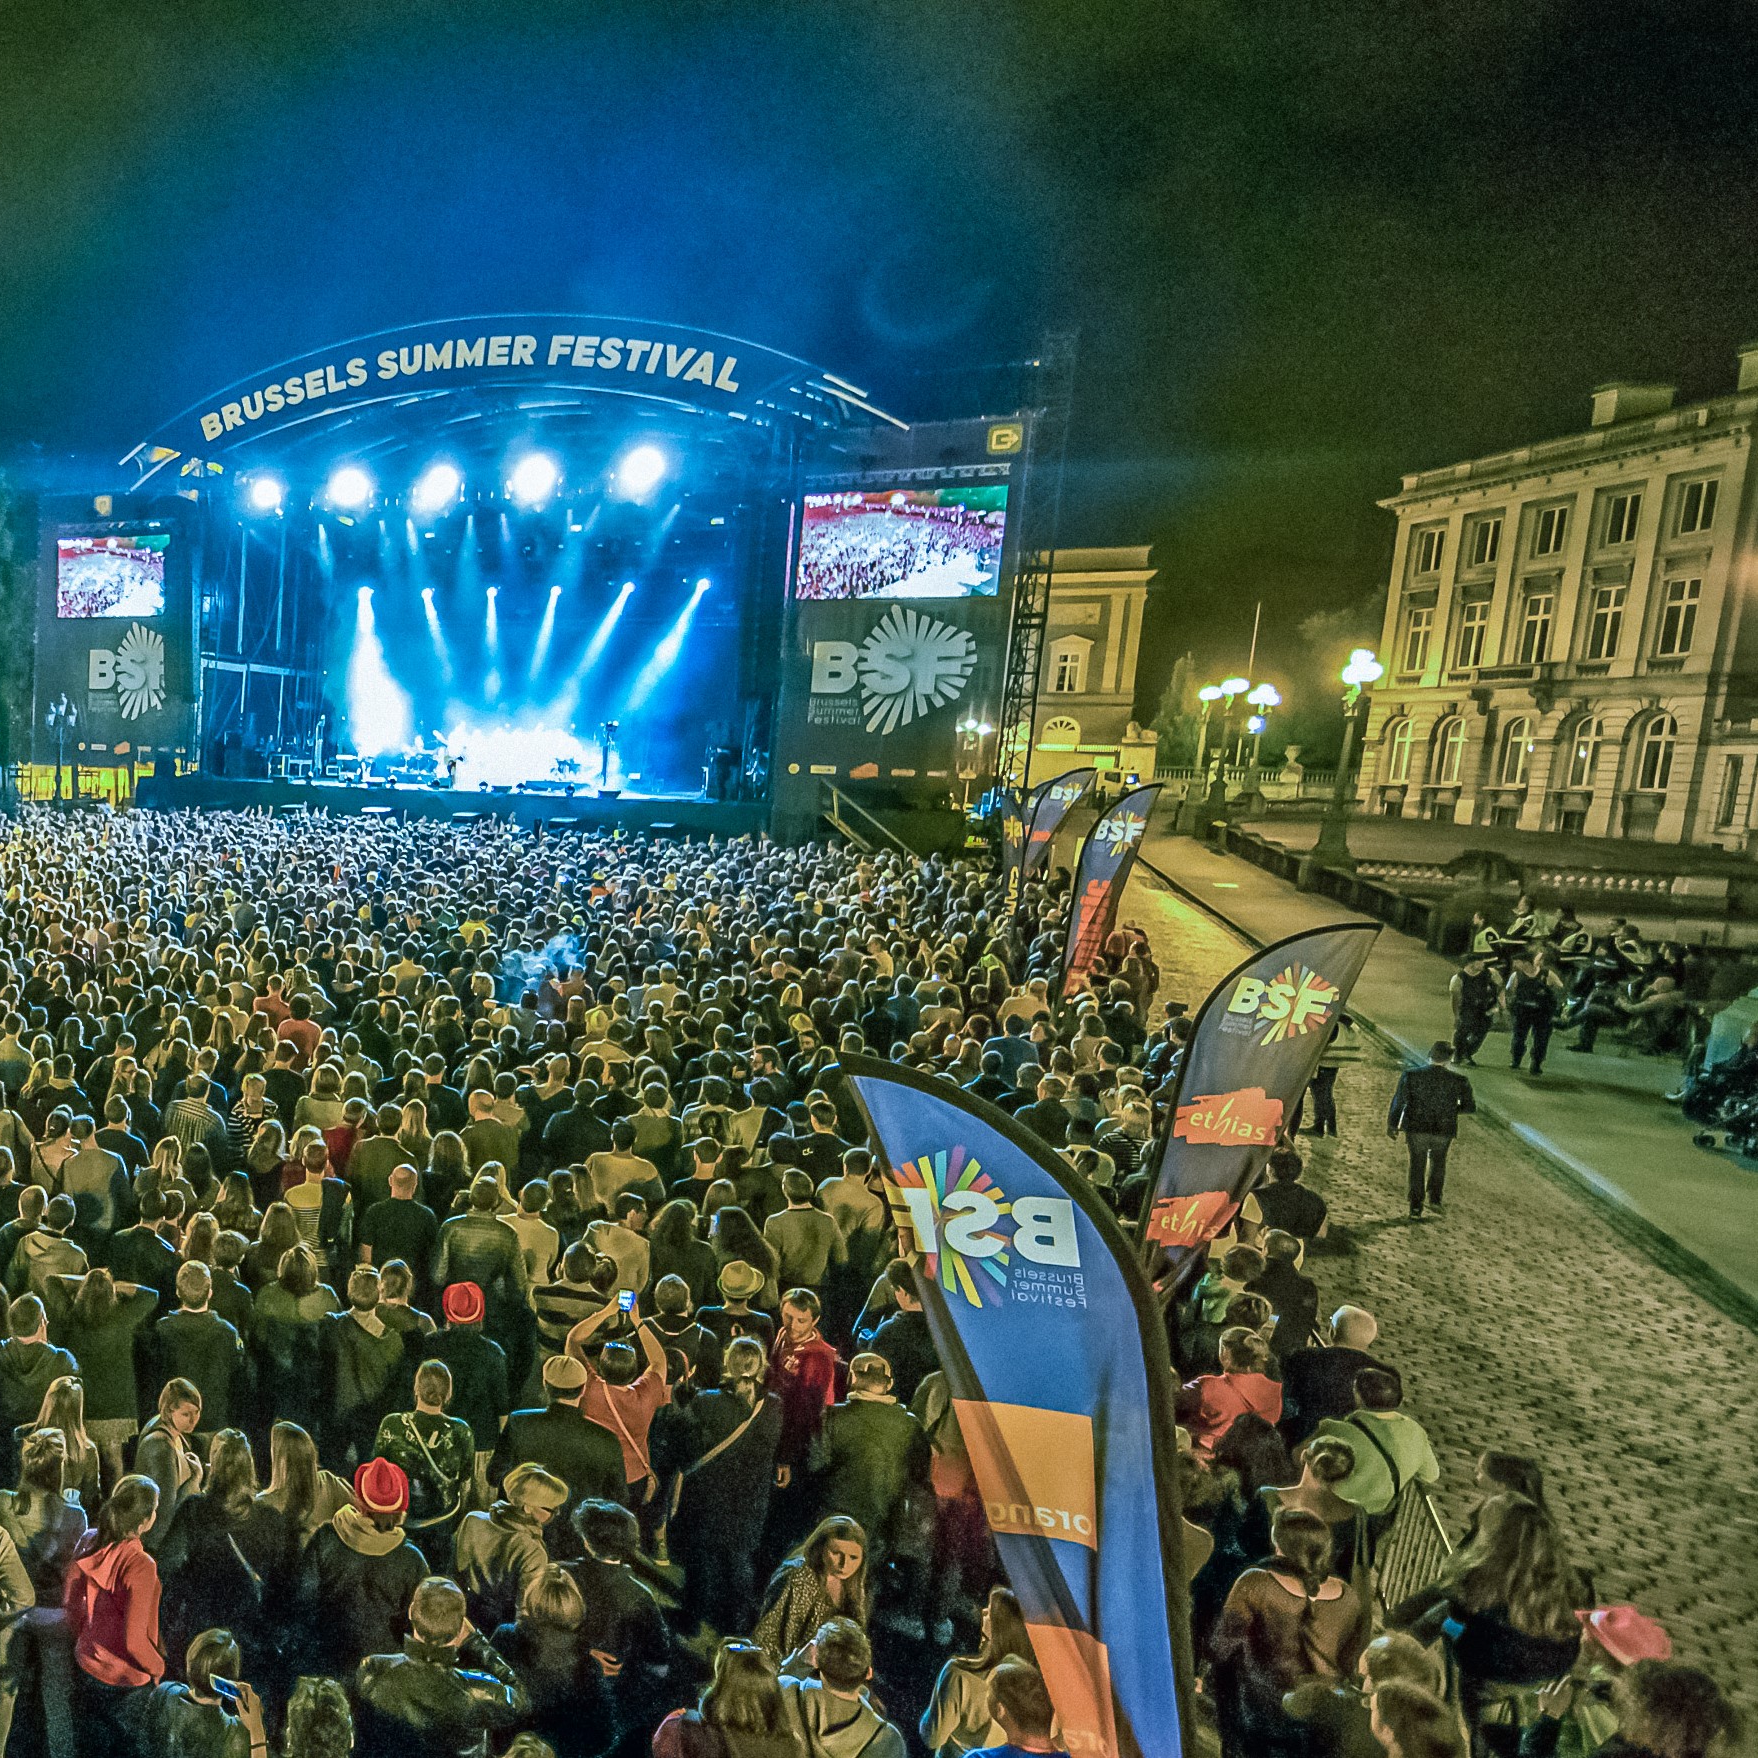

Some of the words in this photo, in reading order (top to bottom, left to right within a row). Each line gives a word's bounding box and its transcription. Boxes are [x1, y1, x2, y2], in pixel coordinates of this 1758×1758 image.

[199, 358, 369, 442] BRUSSELS
[376, 334, 539, 377] SUMMER
[548, 335, 741, 393] FESTIVAL
[811, 640, 967, 695] BSF
[1094, 819, 1146, 843] BSF
[1228, 976, 1335, 1025] BSF
[1190, 1098, 1267, 1141] ethias
